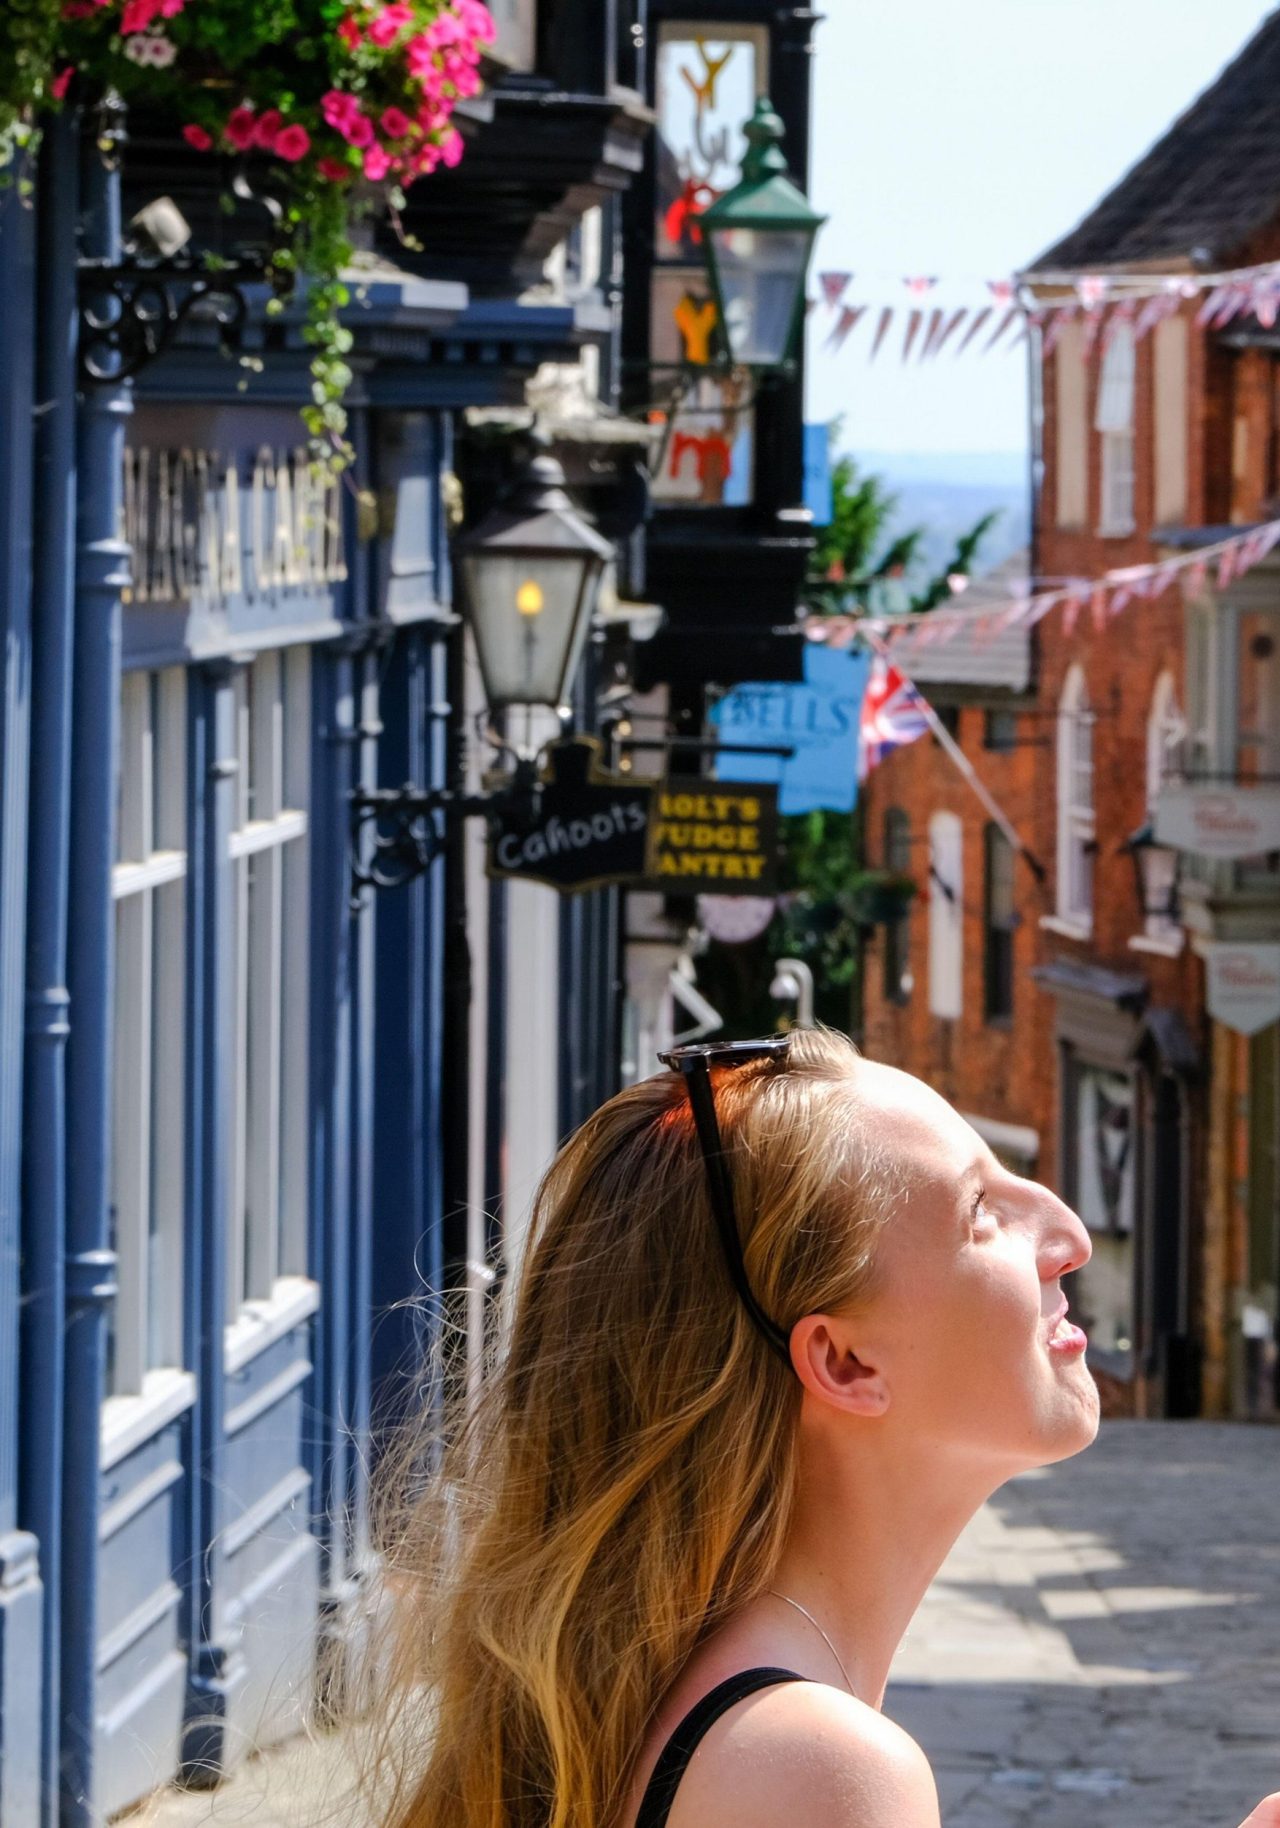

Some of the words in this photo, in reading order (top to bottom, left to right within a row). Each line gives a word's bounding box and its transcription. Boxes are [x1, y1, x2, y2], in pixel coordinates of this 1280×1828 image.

[730, 690, 858, 736] BELLS
[497, 802, 647, 869] Cahoots
[658, 851, 768, 880] ANTRY
